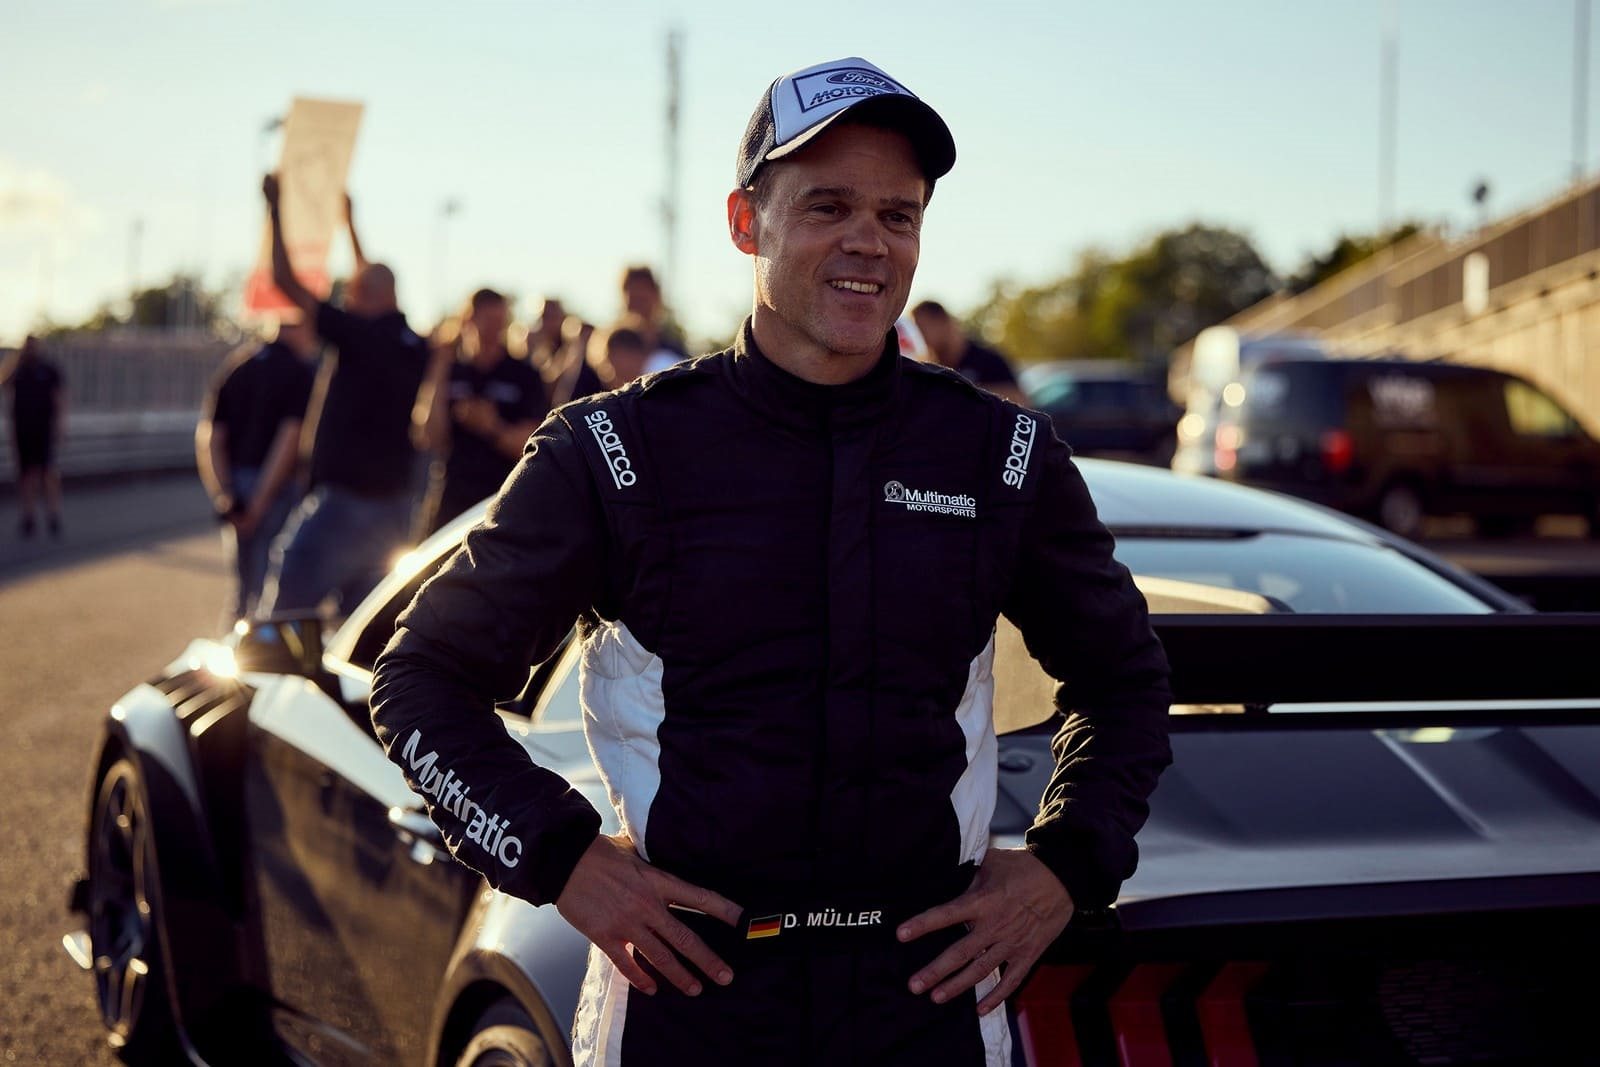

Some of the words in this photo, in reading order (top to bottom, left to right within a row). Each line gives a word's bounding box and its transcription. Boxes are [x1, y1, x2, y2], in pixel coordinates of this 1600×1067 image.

[842, 71, 886, 87] Ford
[584, 410, 637, 489] sparco
[1002, 414, 1036, 490] sparco
[905, 488, 976, 507] Multimatic
[906, 503, 977, 518] MOTORSPORTS
[784, 913, 801, 929] D.
[807, 908, 882, 927] MÜLLER
